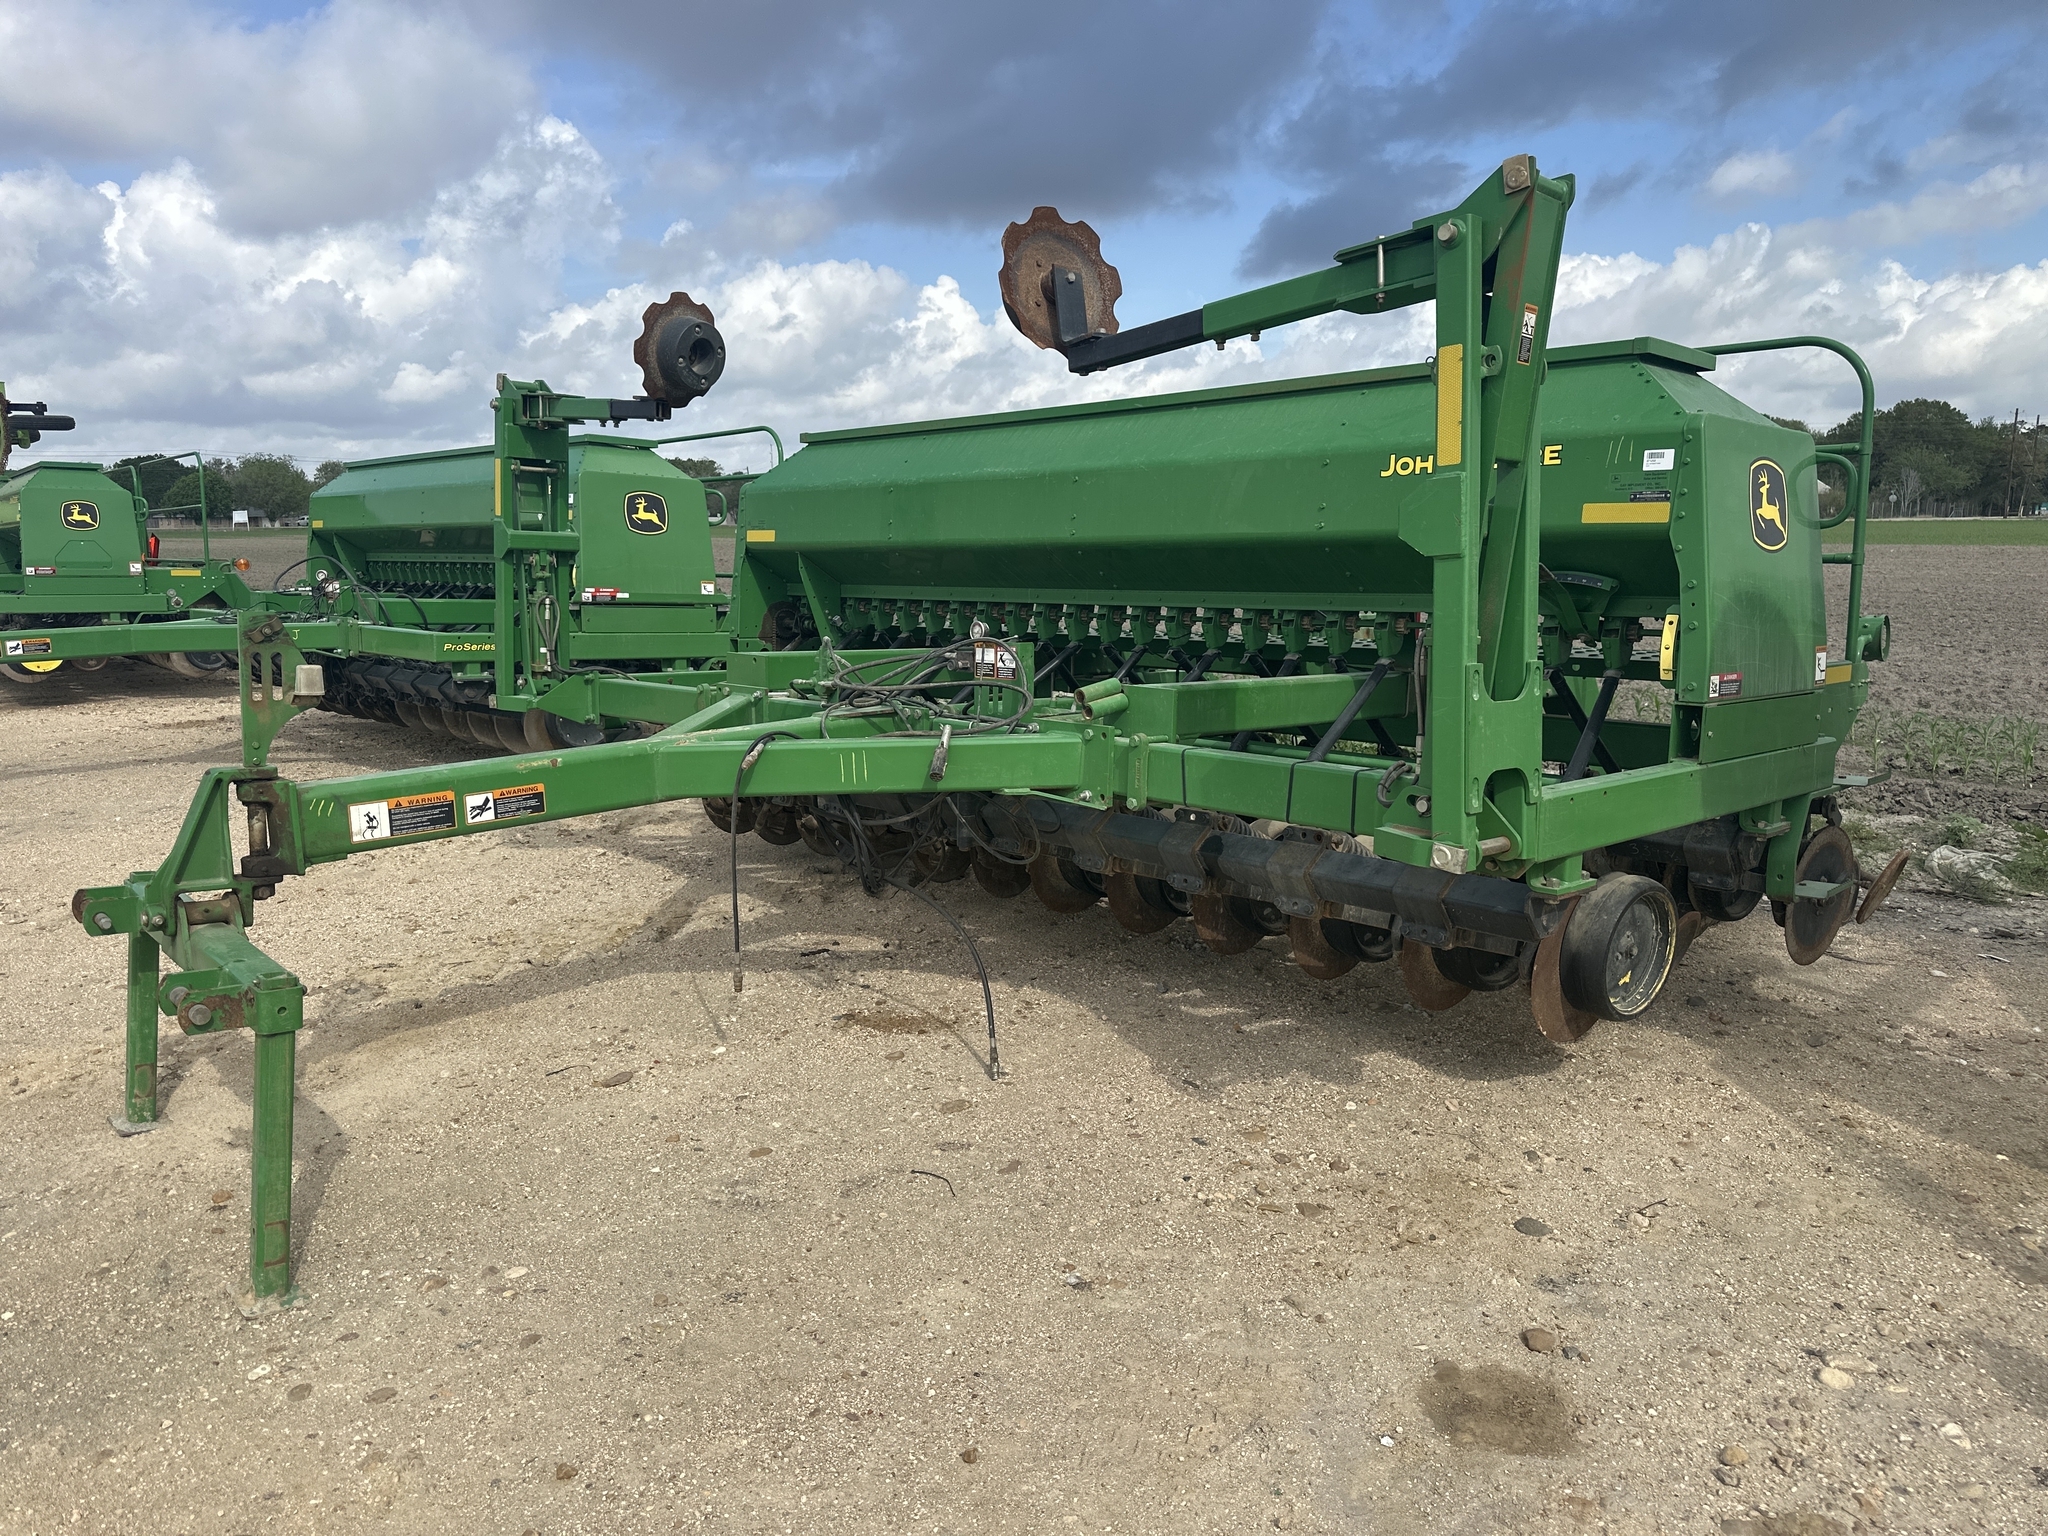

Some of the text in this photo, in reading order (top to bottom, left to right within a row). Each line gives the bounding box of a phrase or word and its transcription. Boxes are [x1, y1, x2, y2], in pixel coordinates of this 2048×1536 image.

[1380, 454, 1434, 478] JOH
[443, 642, 496, 652] ProSeries
[505, 786, 539, 797] WARNING
[407, 795, 448, 806] WARNING
